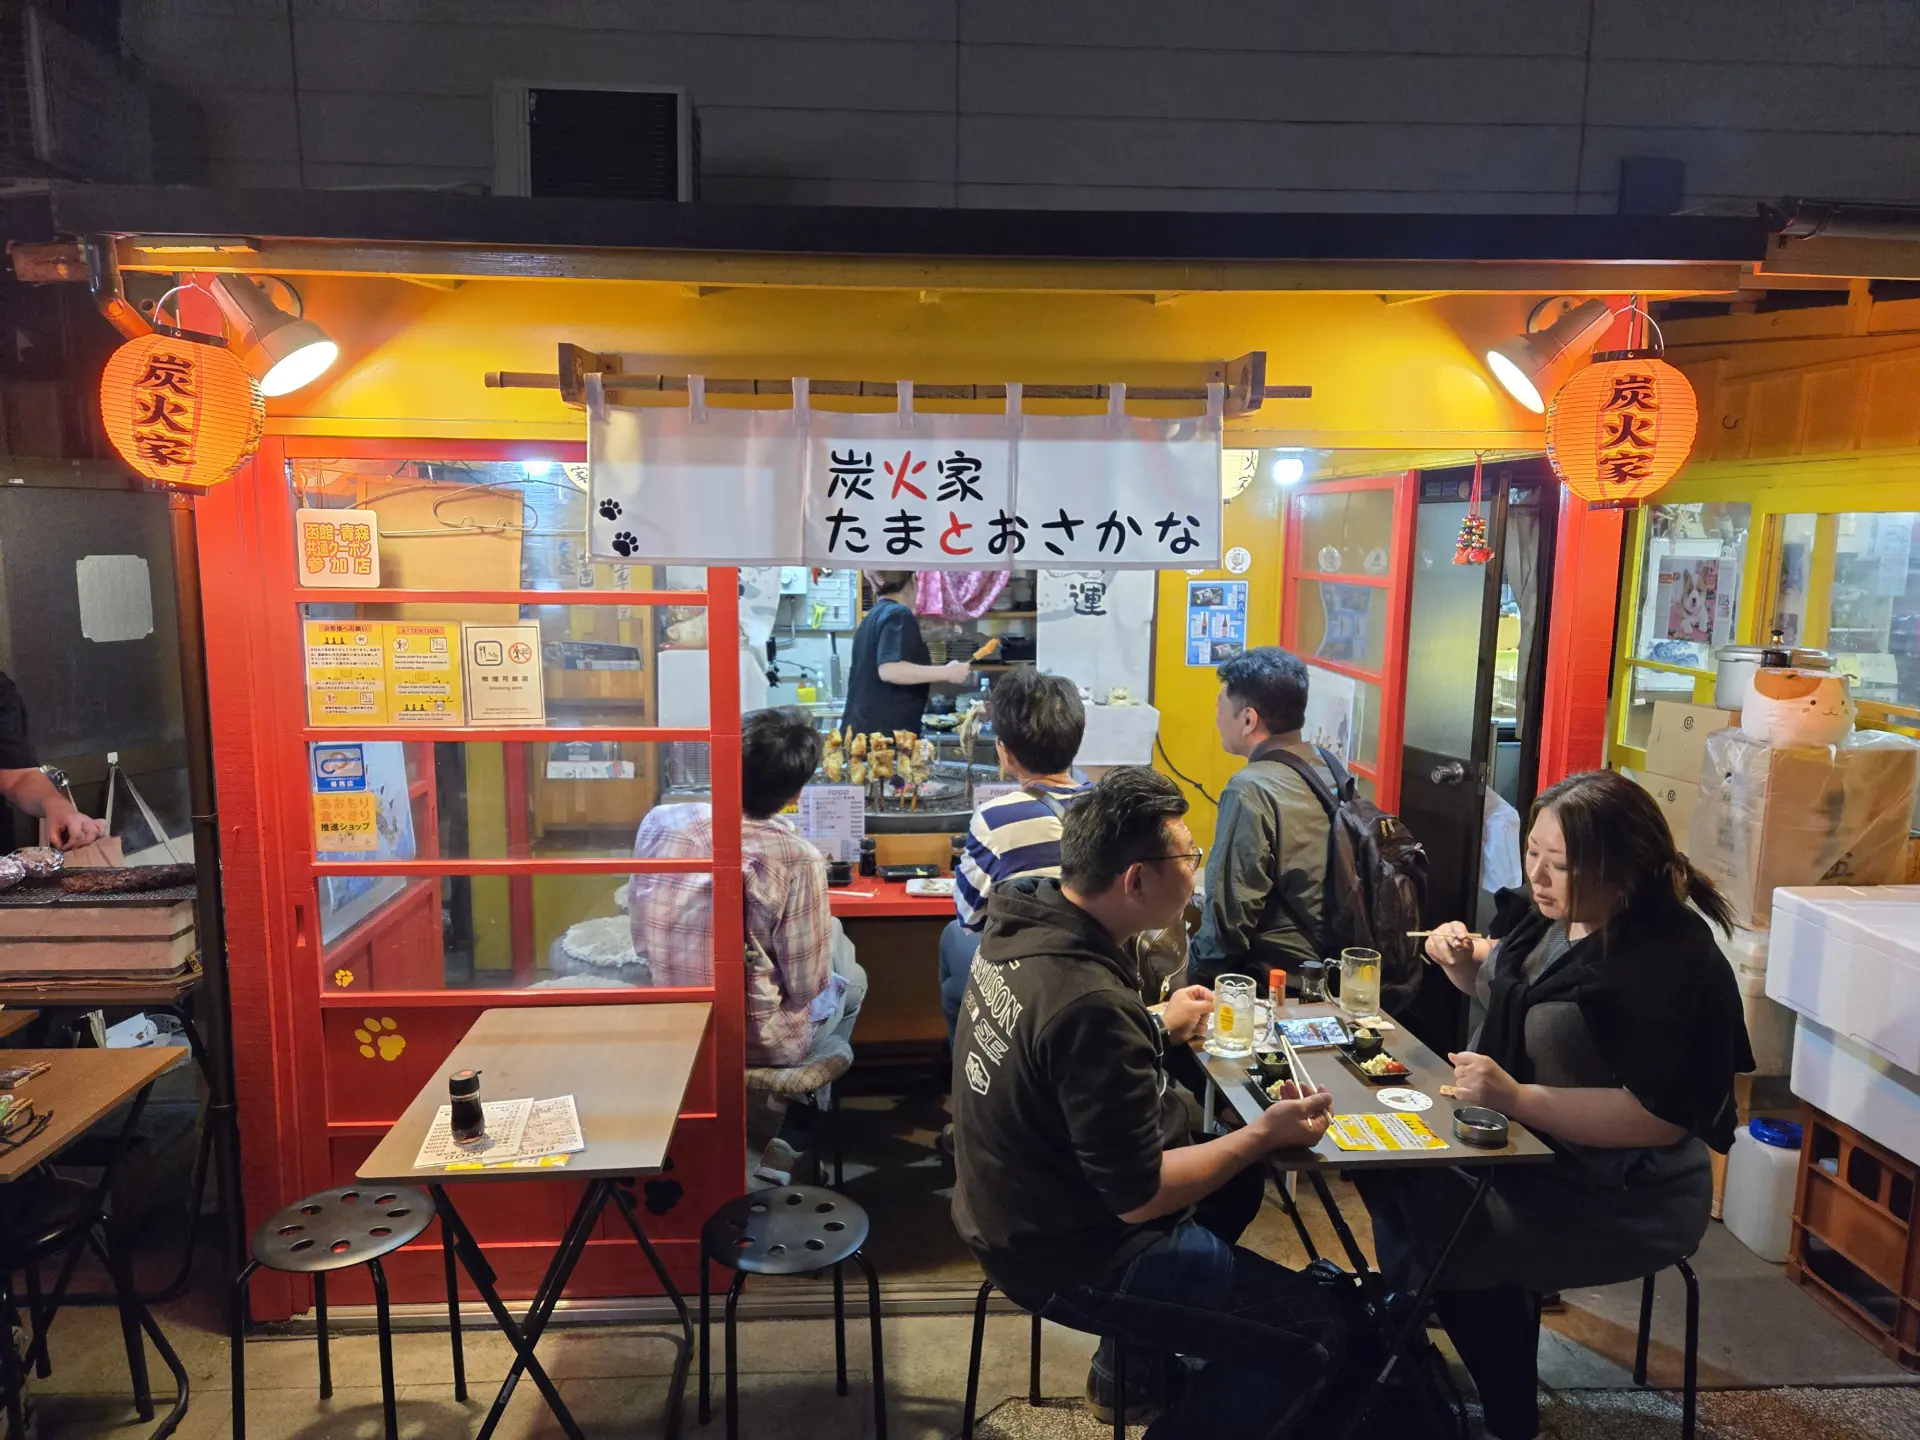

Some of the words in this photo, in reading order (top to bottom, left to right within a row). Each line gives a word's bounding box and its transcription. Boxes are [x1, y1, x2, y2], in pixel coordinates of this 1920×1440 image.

[133, 352, 198, 466] 炭火家
[1599, 374, 1660, 484] 炭火家
[827, 449, 983, 501] 炭火家
[304, 540, 372, 558] 共通クーポン
[826, 507, 1200, 556] たまとおさかな
[306, 556, 372, 575] 参加店
[1069, 581, 1107, 616] 運
[321, 822, 371, 832] 推進ショップ
[444, 1151, 485, 1160] FOOD
